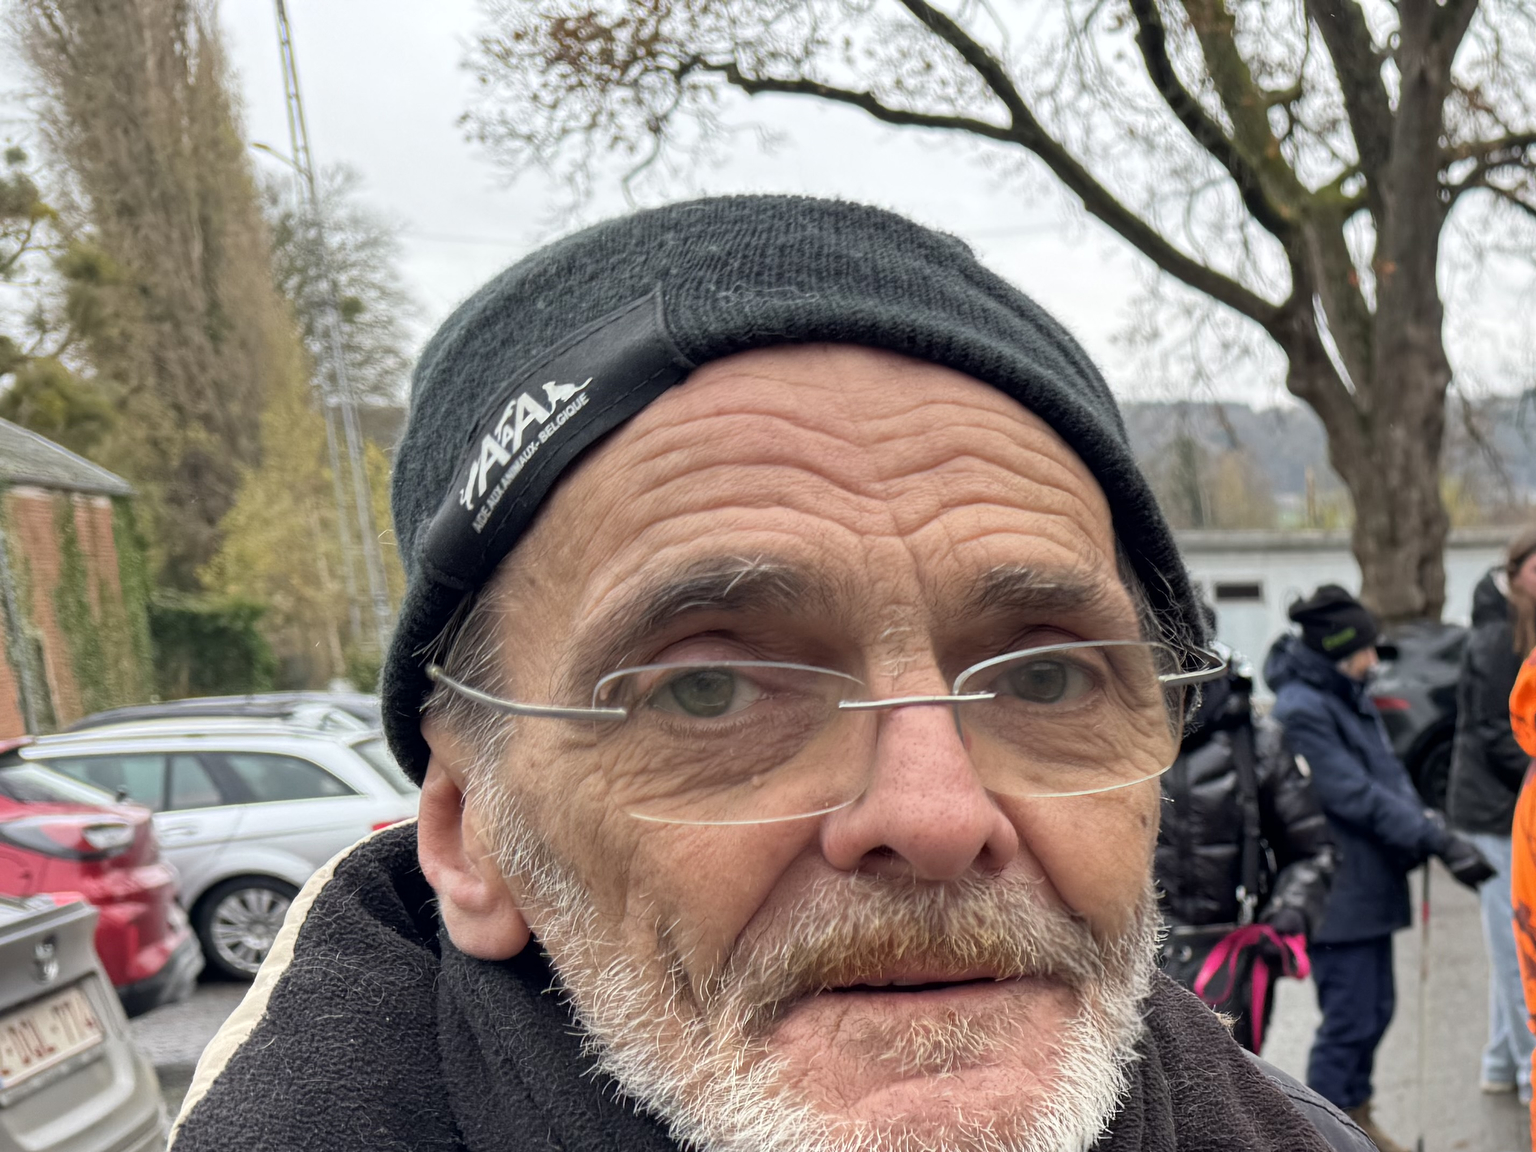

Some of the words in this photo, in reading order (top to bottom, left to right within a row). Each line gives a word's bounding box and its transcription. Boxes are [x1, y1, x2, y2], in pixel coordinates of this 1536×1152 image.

[471, 504, 493, 534] AIDE
[486, 483, 505, 511] AUX
[537, 391, 591, 445] BELGIQUE
